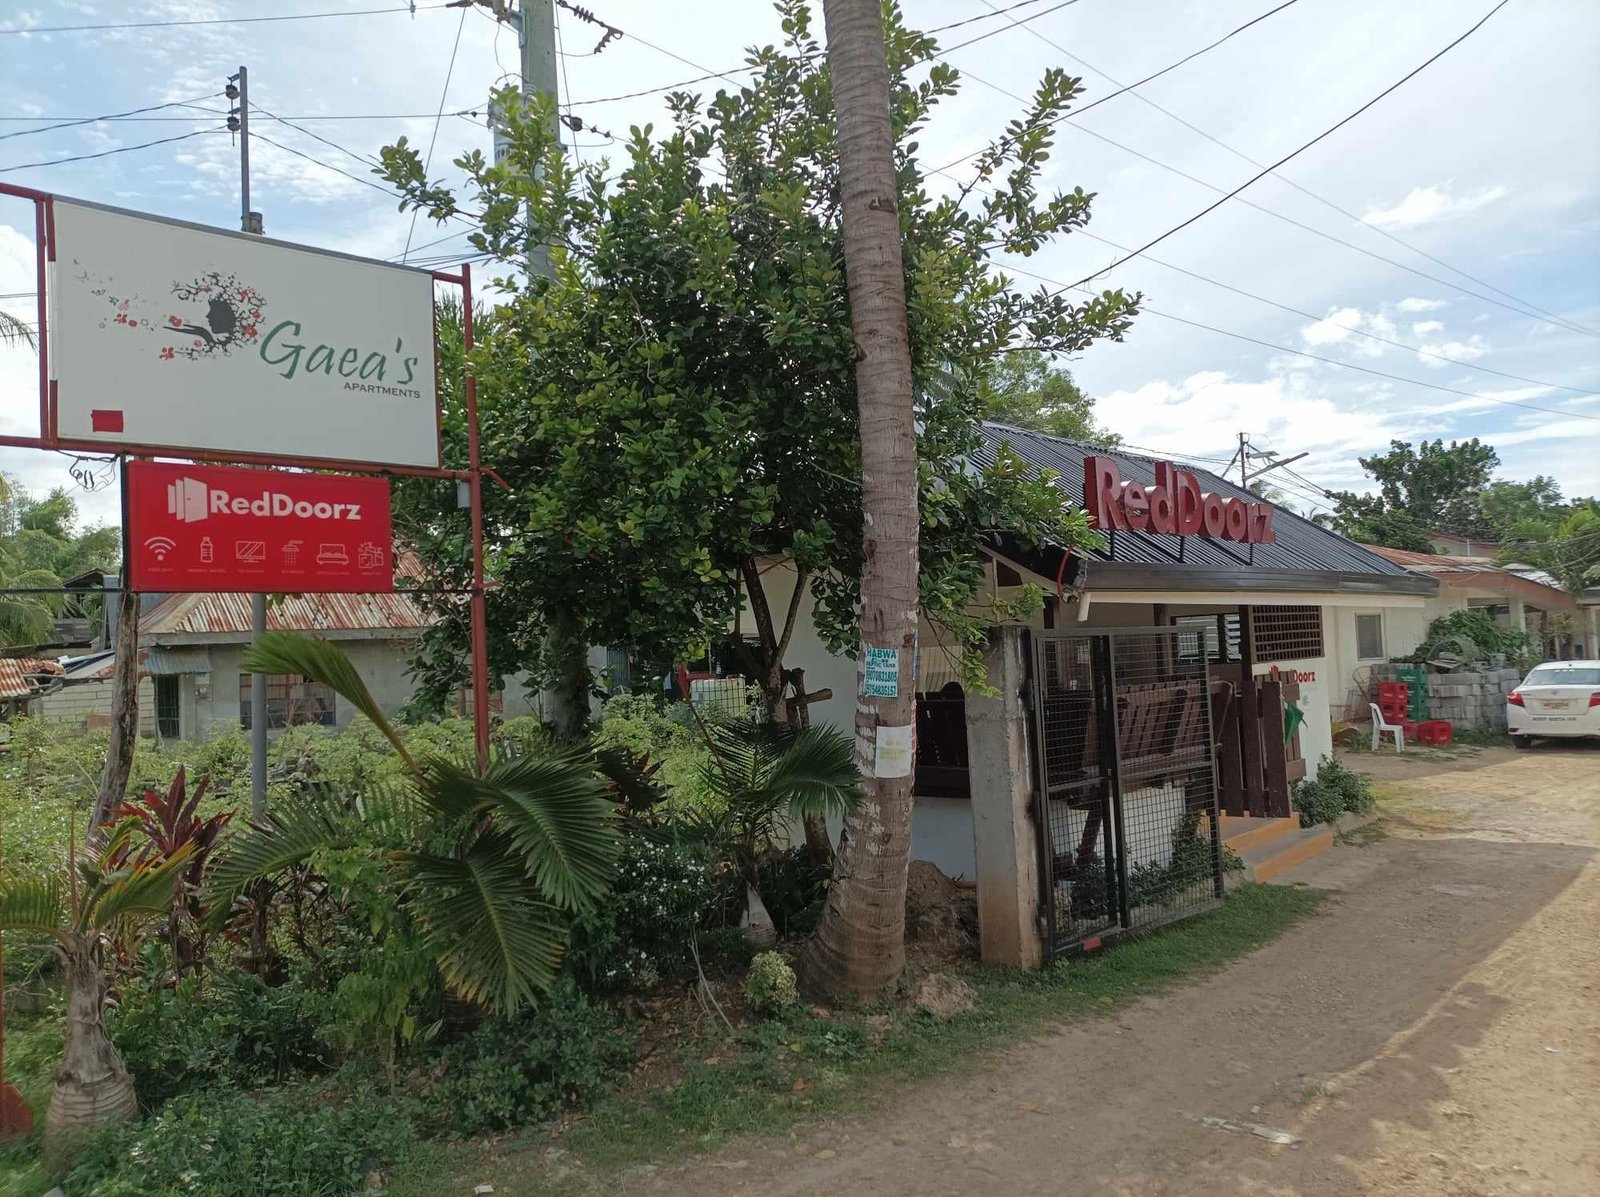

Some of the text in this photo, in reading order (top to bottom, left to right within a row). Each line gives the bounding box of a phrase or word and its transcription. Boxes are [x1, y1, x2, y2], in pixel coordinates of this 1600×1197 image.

[259, 320, 418, 385] Gaea's
[343, 382, 421, 398] APARTMENTS
[210, 489, 361, 520] RedDoorz
[1083, 455, 1276, 544] RedDoorz
[867, 648, 897, 659] HABWA
